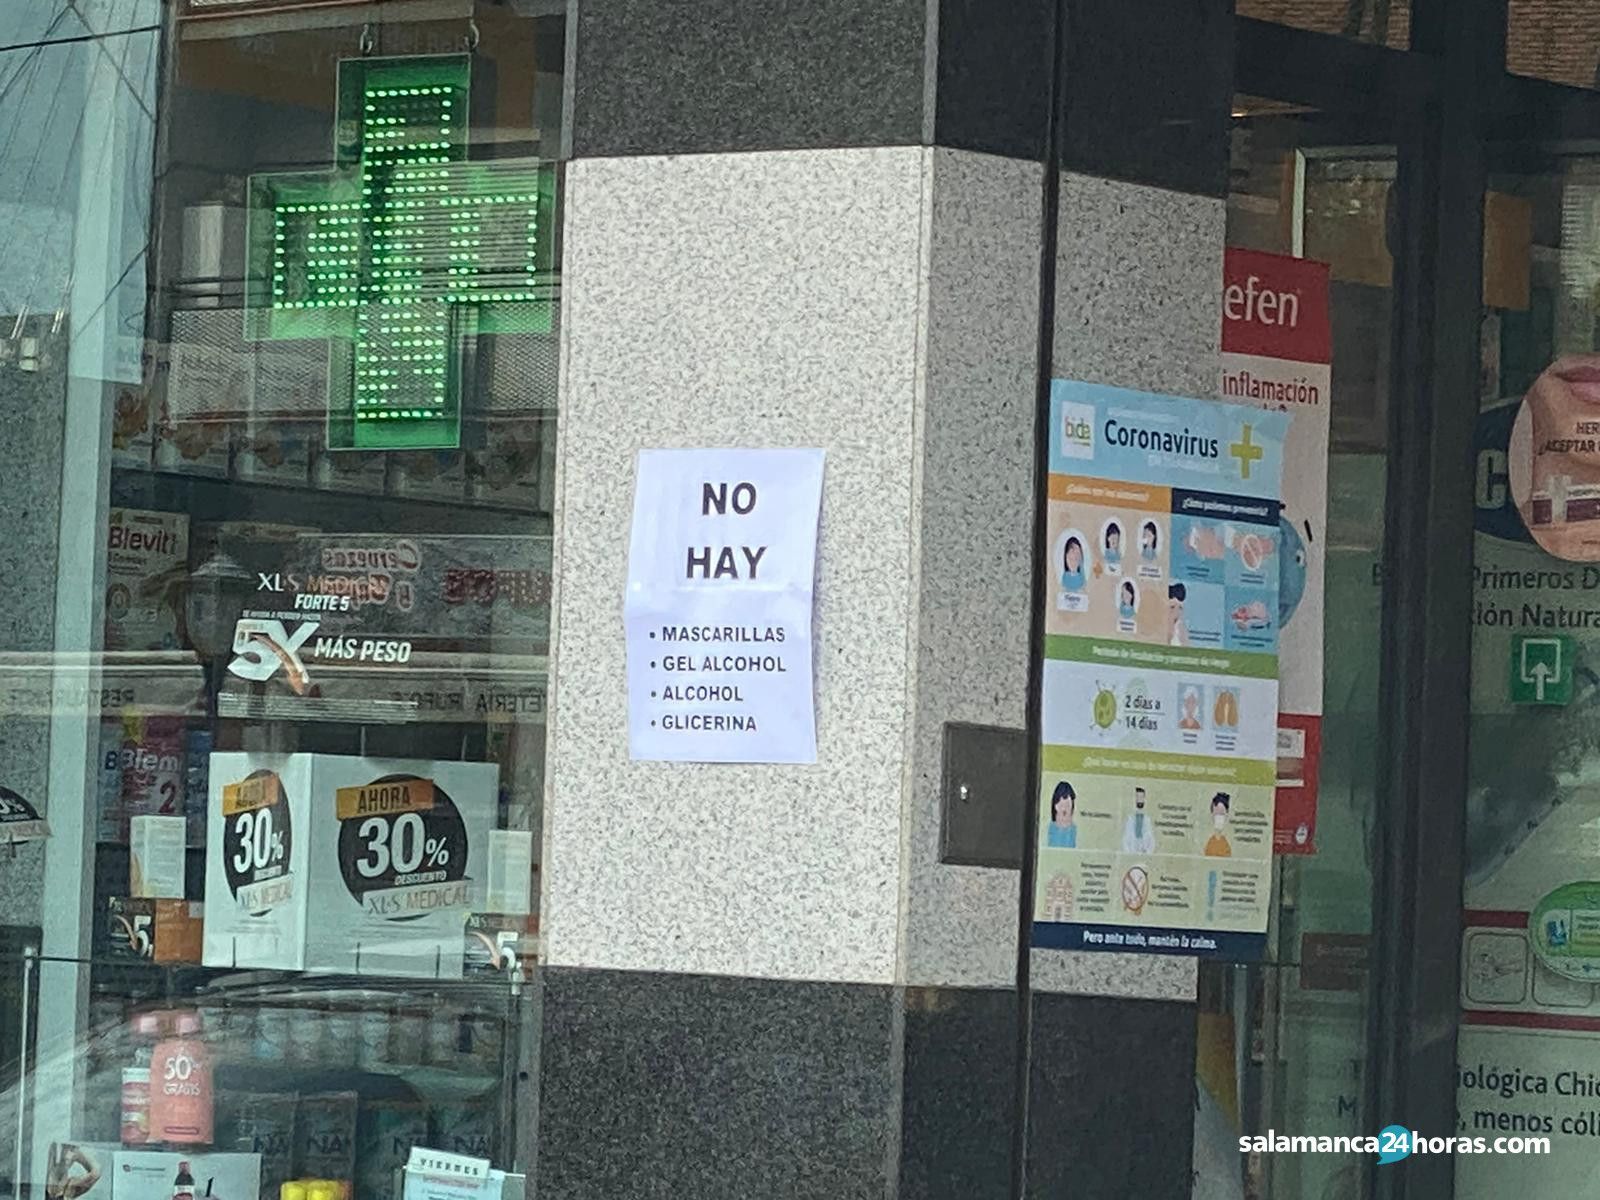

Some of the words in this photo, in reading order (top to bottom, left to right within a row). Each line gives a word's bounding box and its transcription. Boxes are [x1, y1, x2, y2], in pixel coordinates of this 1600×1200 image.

[1224, 276, 1298, 327] efen
[1223, 370, 1319, 405] inflamación
[1104, 419, 1218, 458] Coronavirus
[702, 482, 757, 515] NO
[686, 547, 766, 579] HAY
[295, 594, 340, 610] FORTE
[663, 627, 786, 643] MASCARILLAS
[315, 635, 357, 659] MÁS
[360, 640, 412, 663] PESO
[663, 656, 696, 672] GEL
[702, 656, 786, 672] ALCOHOL
[663, 686, 744, 702] ALCOHOL
[1125, 695, 1131, 708] 2
[1133, 695, 1153, 709] días
[1155, 700, 1161, 710] a
[662, 715, 757, 731] GLICERINA
[1126, 716, 1136, 729] 14
[1139, 716, 1158, 730] días
[159, 781, 176, 813] 2
[357, 785, 411, 814] AHORA
[234, 808, 284, 873] 30%
[356, 812, 449, 878] 30%
[406, 885, 471, 909] MEDICAL
[1083, 930, 1104, 943] Pero
[1474, 1110, 1553, 1133] menos
